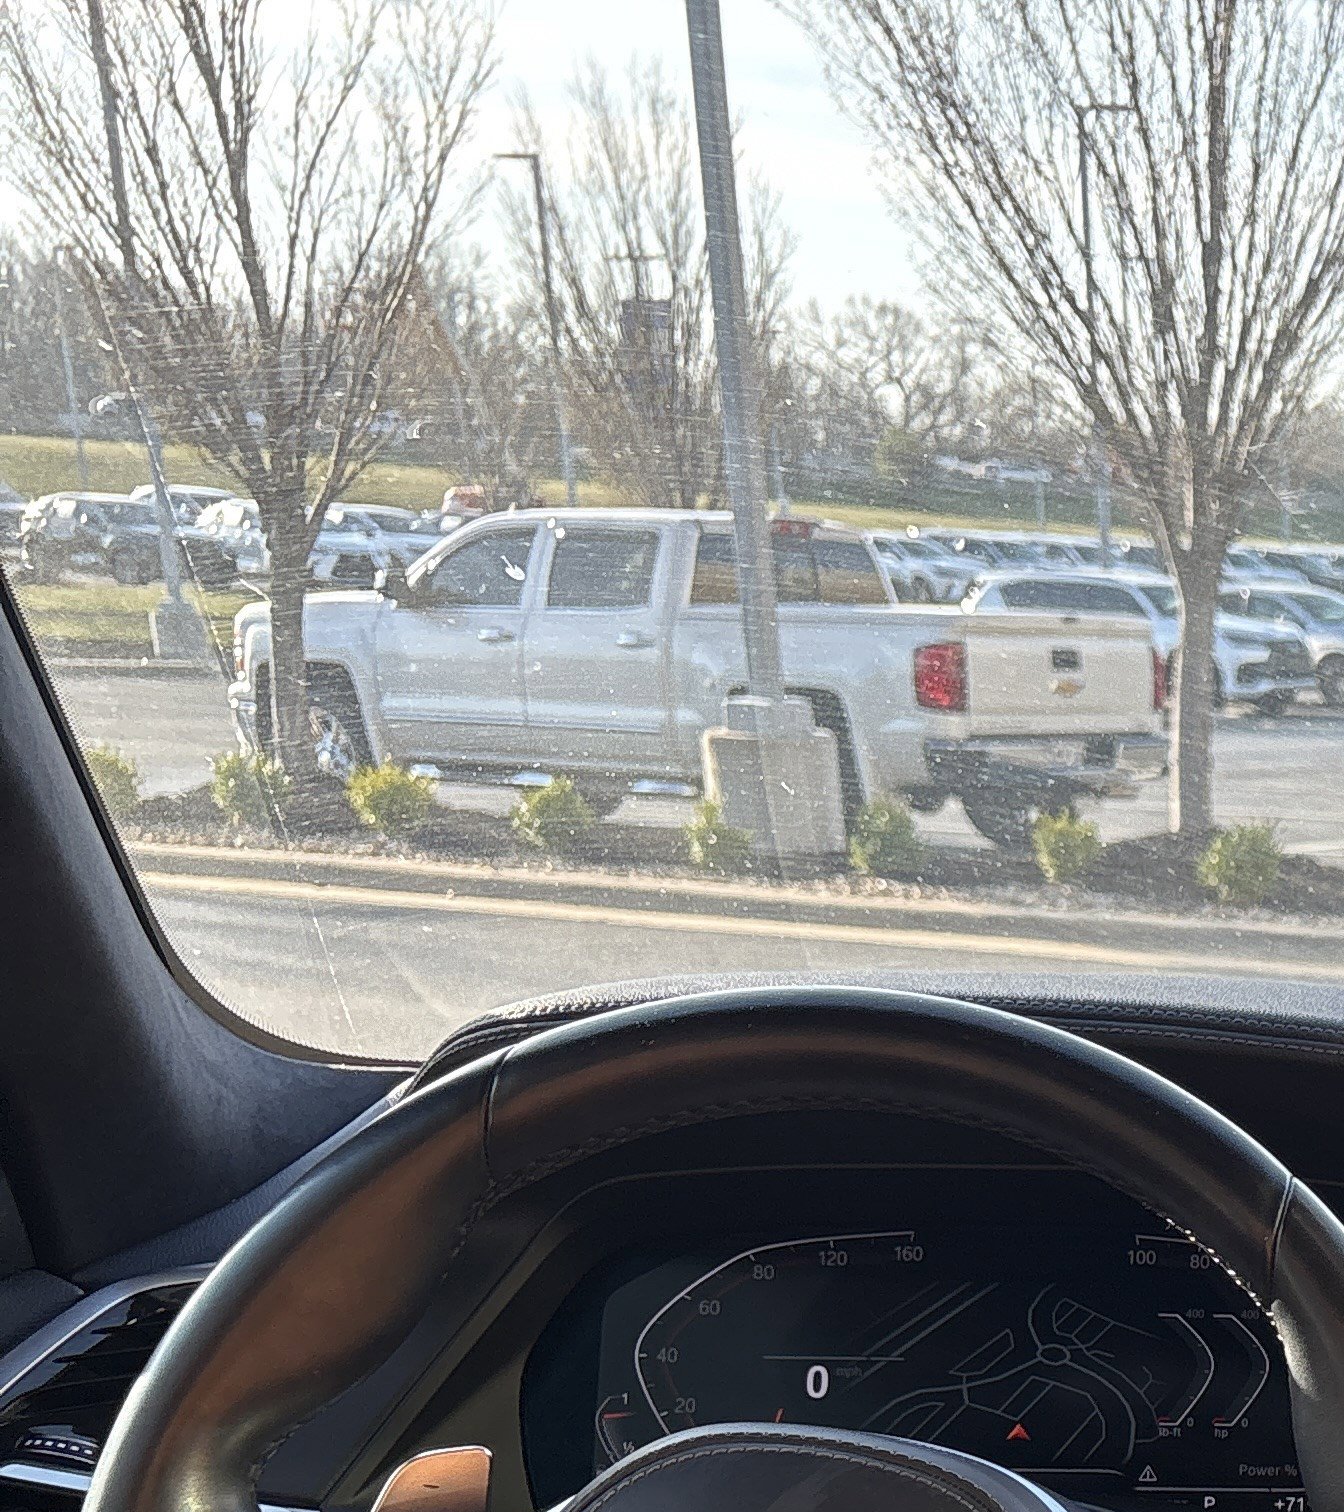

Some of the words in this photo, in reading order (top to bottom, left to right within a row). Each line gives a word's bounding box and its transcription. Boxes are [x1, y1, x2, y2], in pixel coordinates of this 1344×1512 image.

[819, 1250, 847, 1266] 120
[895, 1246, 923, 1262] 160
[1128, 1249, 1157, 1265] 100
[1190, 1254, 1210, 1269] 80
[753, 1264, 775, 1280] 80
[700, 1300, 721, 1315] 60
[656, 1347, 679, 1363] 40
[805, 1365, 830, 1399] 0
[674, 1398, 697, 1413] 20
[1238, 1464, 1282, 1477] Power
[1204, 1496, 1216, 1509] P
